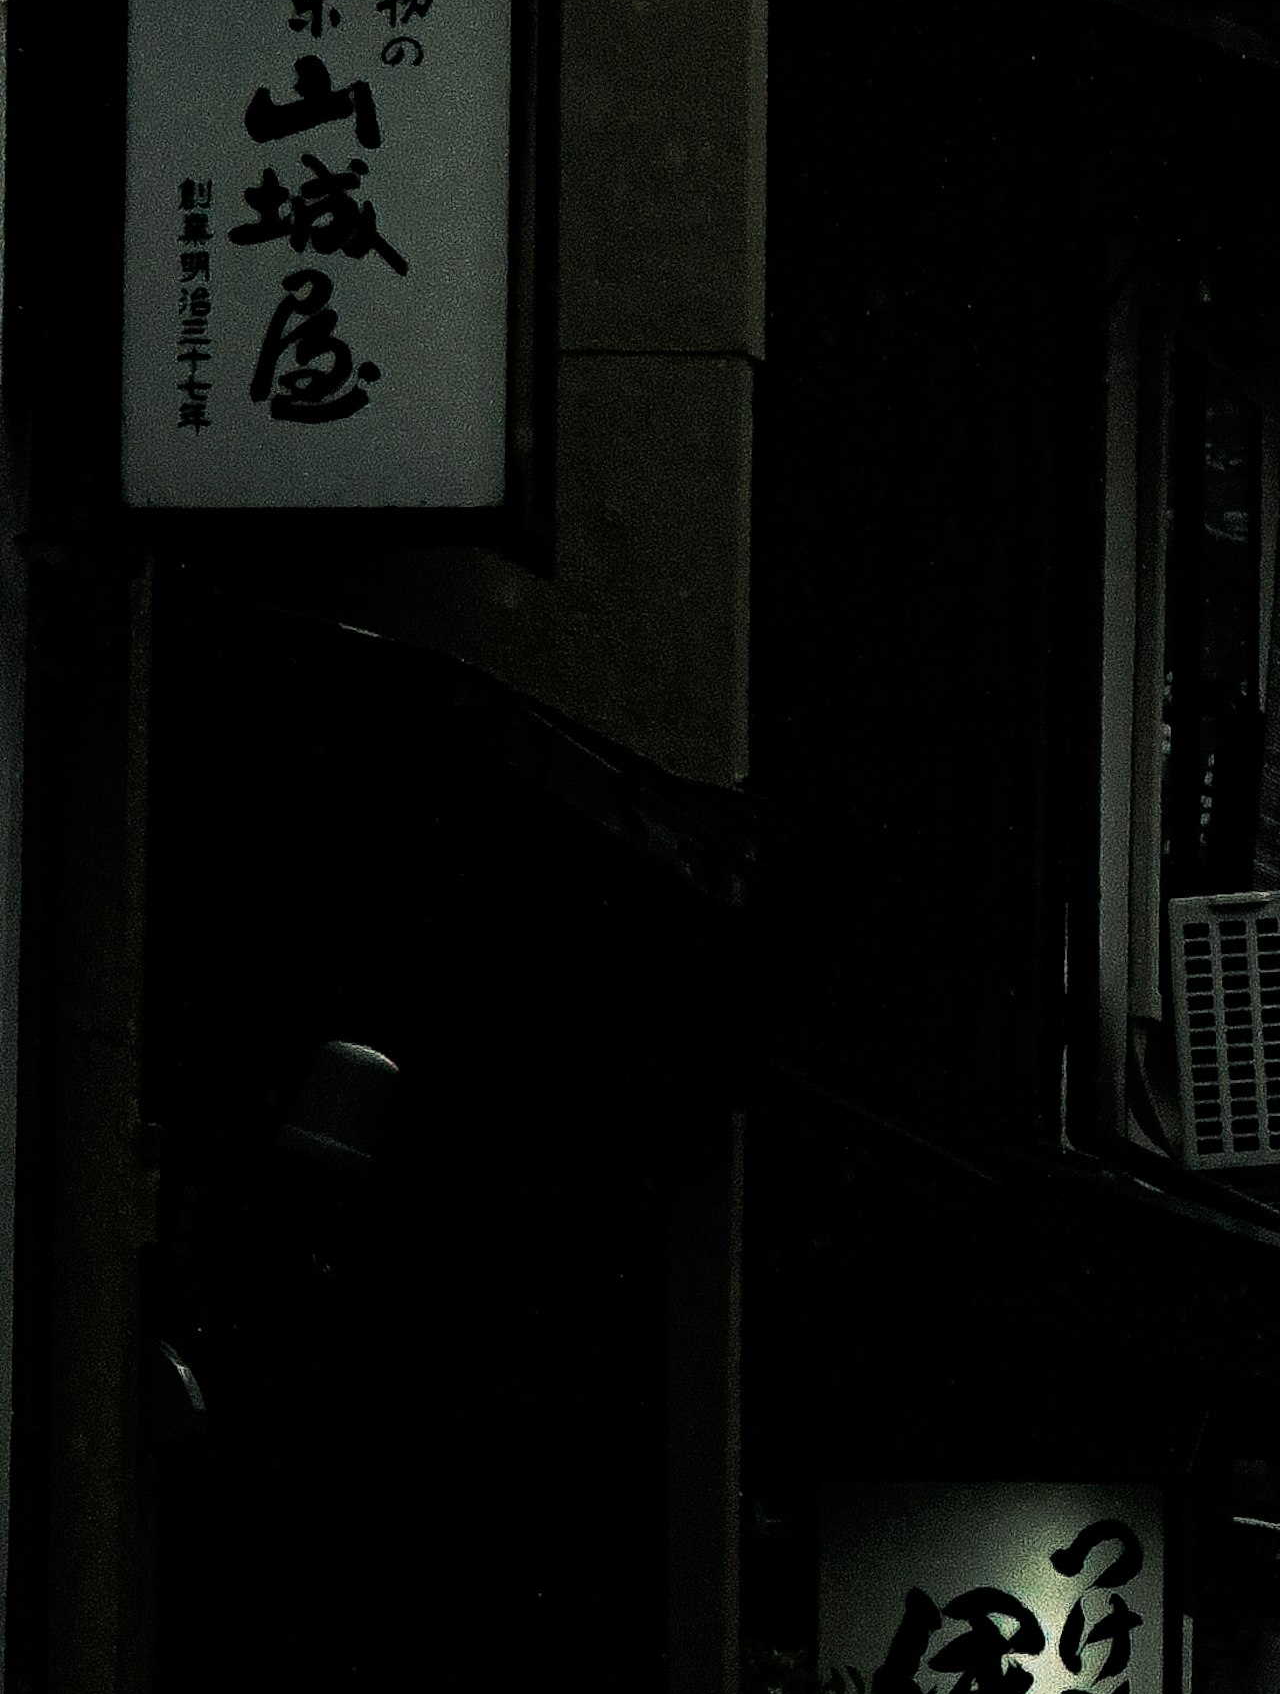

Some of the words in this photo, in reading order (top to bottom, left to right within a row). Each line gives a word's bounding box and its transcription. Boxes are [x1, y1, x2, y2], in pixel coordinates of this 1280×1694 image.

[177, 177, 214, 435] 創業明治三十七年
